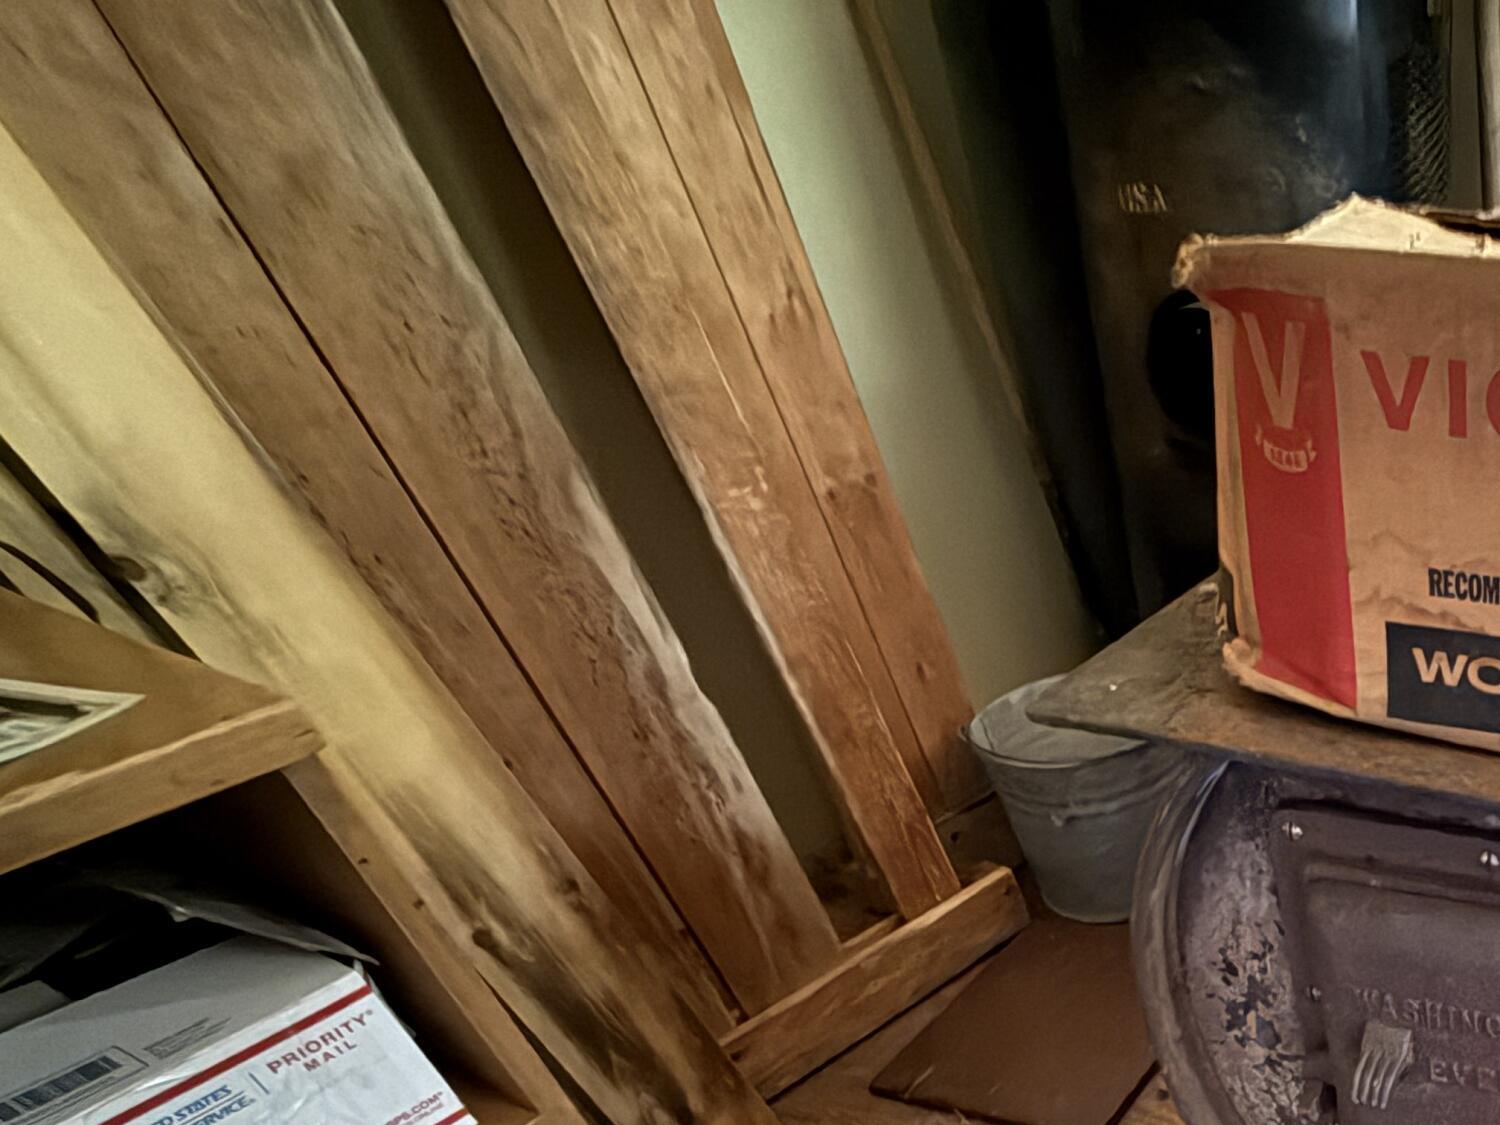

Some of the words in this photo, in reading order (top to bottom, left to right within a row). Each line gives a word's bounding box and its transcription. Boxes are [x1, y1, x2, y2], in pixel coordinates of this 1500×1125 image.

[266, 1013, 368, 1074] PRIORITY
[303, 1040, 358, 1072] MAIL
[174, 1084, 232, 1122] STATES
